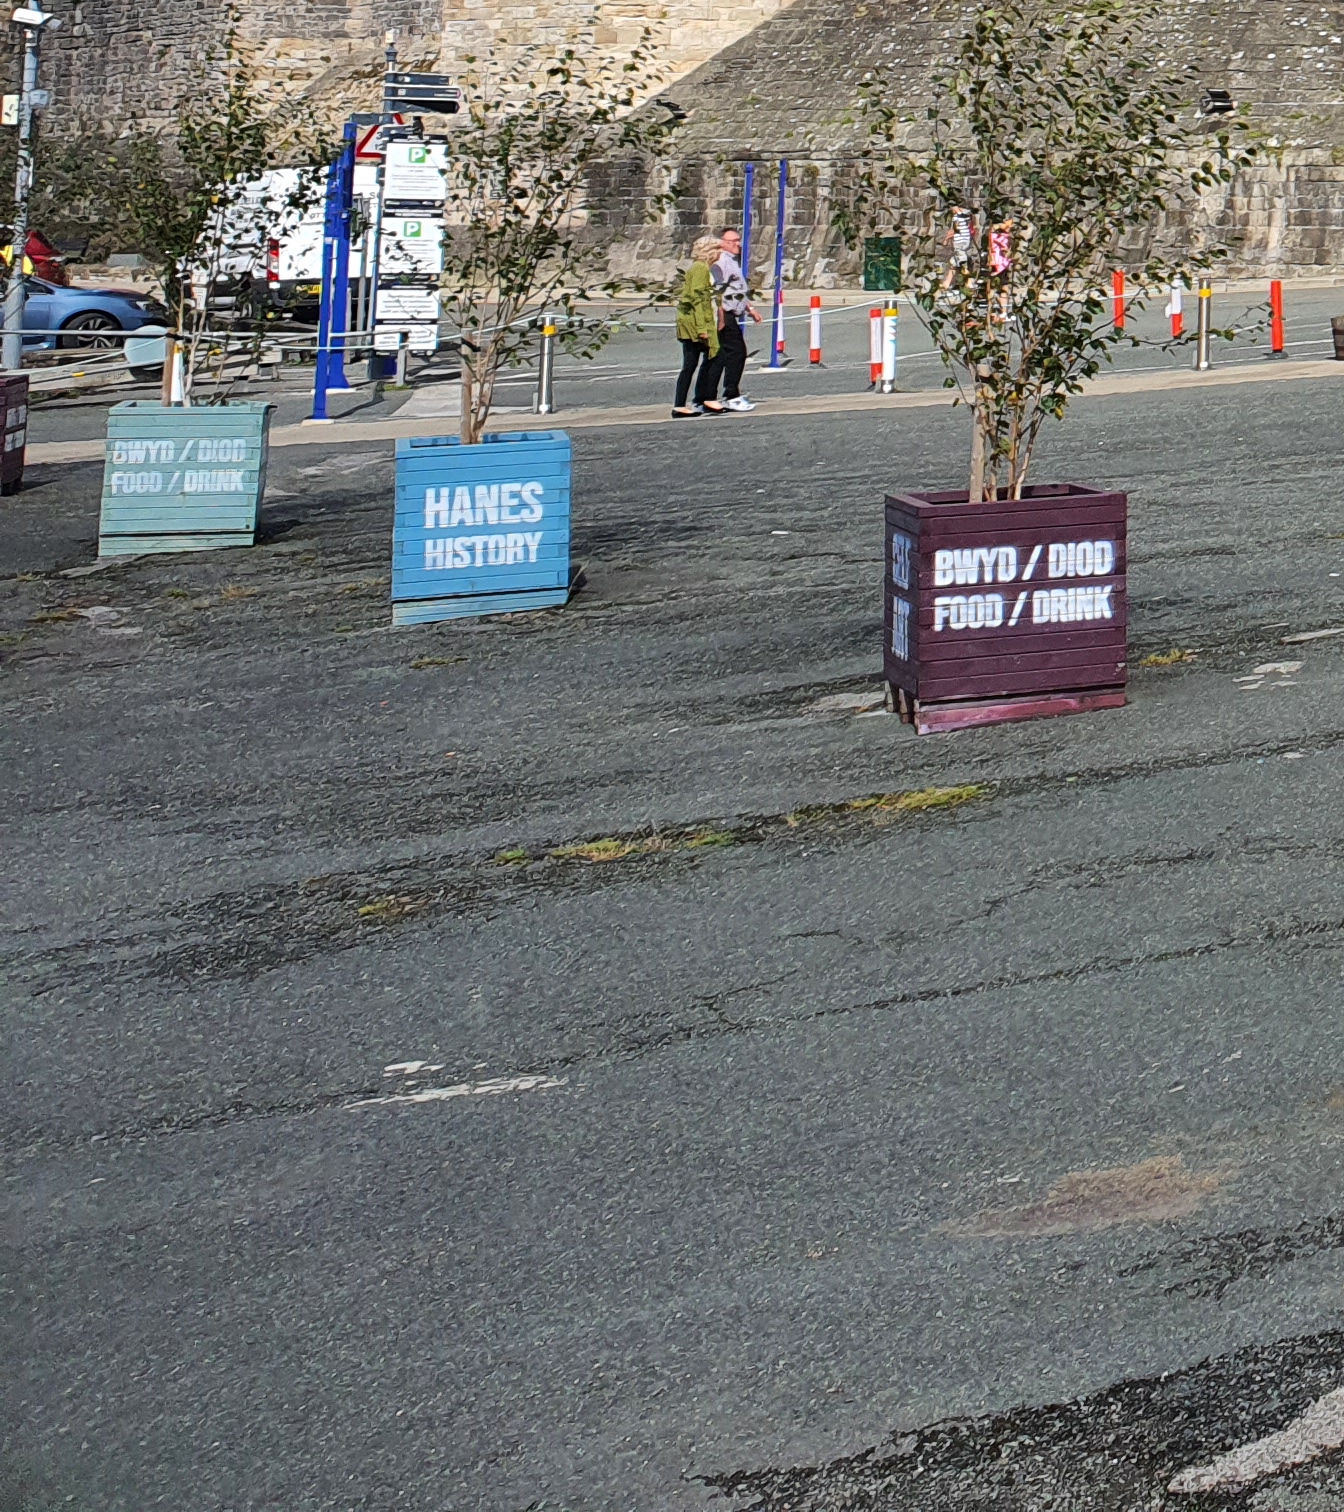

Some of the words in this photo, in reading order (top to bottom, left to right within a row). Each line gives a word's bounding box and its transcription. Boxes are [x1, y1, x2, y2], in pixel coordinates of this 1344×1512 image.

[112, 440, 175, 464] BWYD
[197, 438, 247, 463] DIOD
[111, 471, 163, 496] FOOD
[184, 469, 245, 493] DRINK
[424, 481, 544, 529] HANES
[424, 531, 544, 570] HISTORY
[934, 546, 1017, 587] BWYD
[1022, 544, 1043, 581] /
[1048, 540, 1114, 579] DIOD
[933, 593, 1003, 632] FOOD
[1007, 591, 1027, 627] /
[1032, 585, 1113, 625] DRINK
